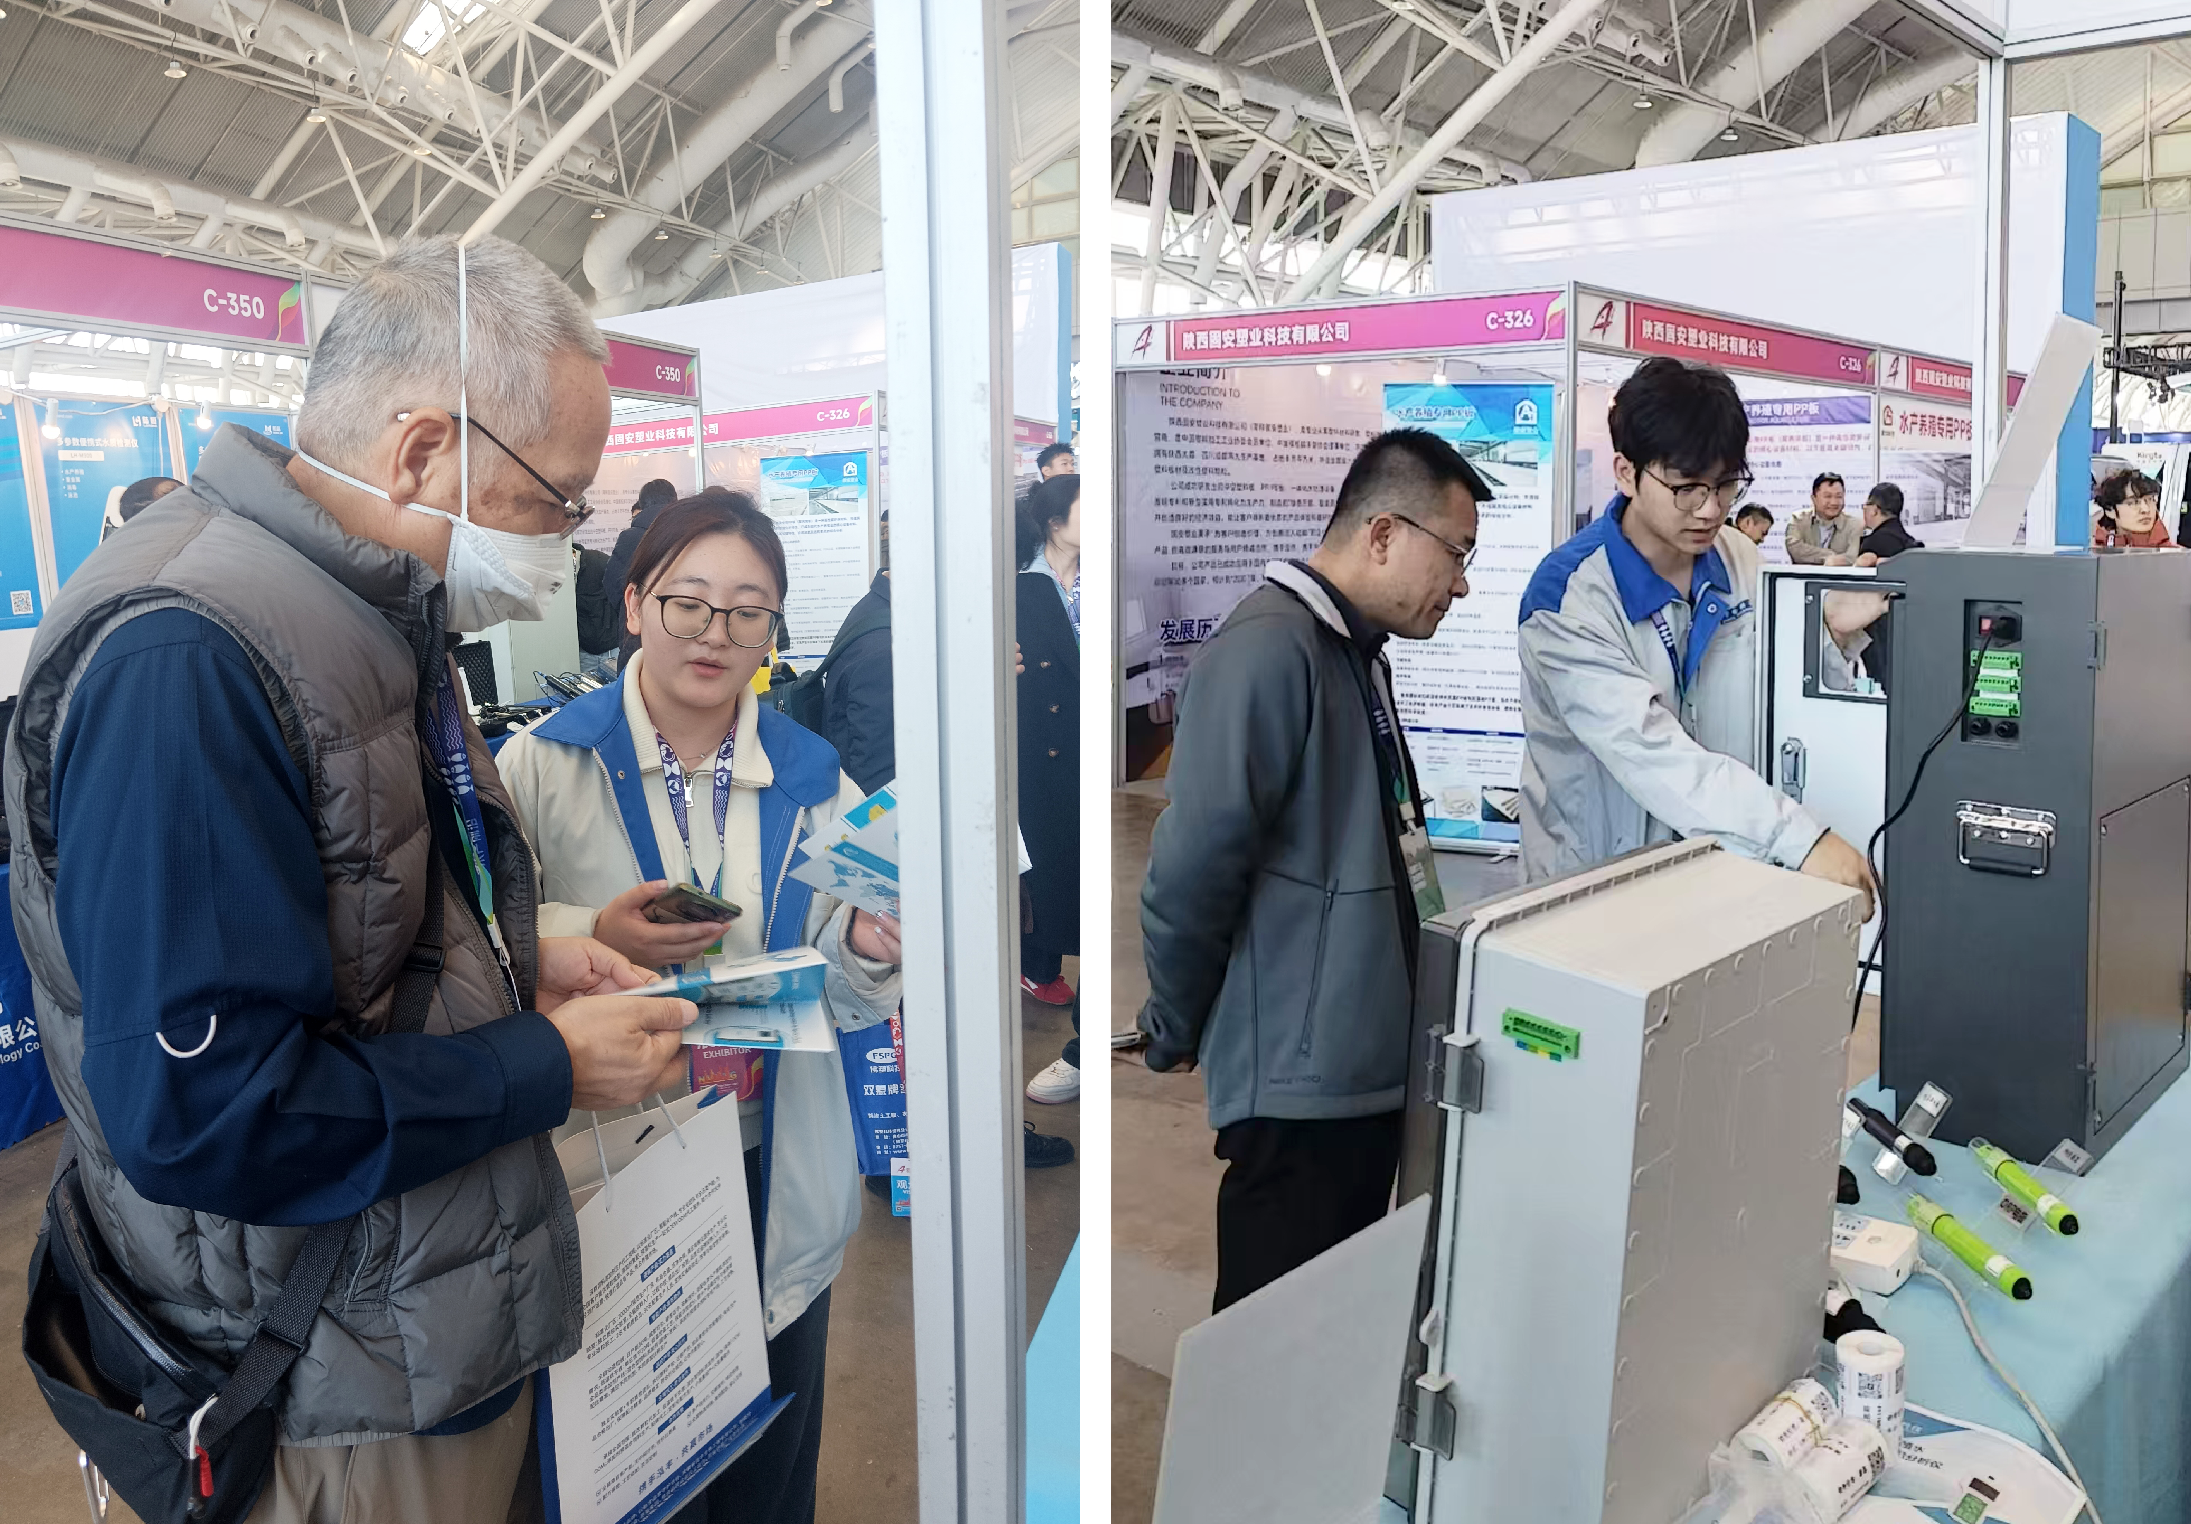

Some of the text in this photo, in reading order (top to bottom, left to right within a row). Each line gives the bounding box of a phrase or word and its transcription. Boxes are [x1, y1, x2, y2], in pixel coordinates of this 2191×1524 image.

[203, 288, 265, 320] C-350
[1486, 309, 1534, 330] C-326
[1182, 321, 1350, 351] 陕西固安塑业科技有限公司
[1641, 319, 1769, 360] 陕西固安塑业科技有限公司
[655, 364, 681, 383] C-350
[1839, 356, 1862, 374] C-326
[1160, 383, 1241, 398] INTRODUCTION TO
[1161, 395, 1224, 410] THE COMPANY
[816, 407, 850, 422] C-326
[1160, 616, 1219, 641] 发展历
[703, 1046, 752, 1059] EXHIBITOR
[896, 1179, 911, 1190] 观
